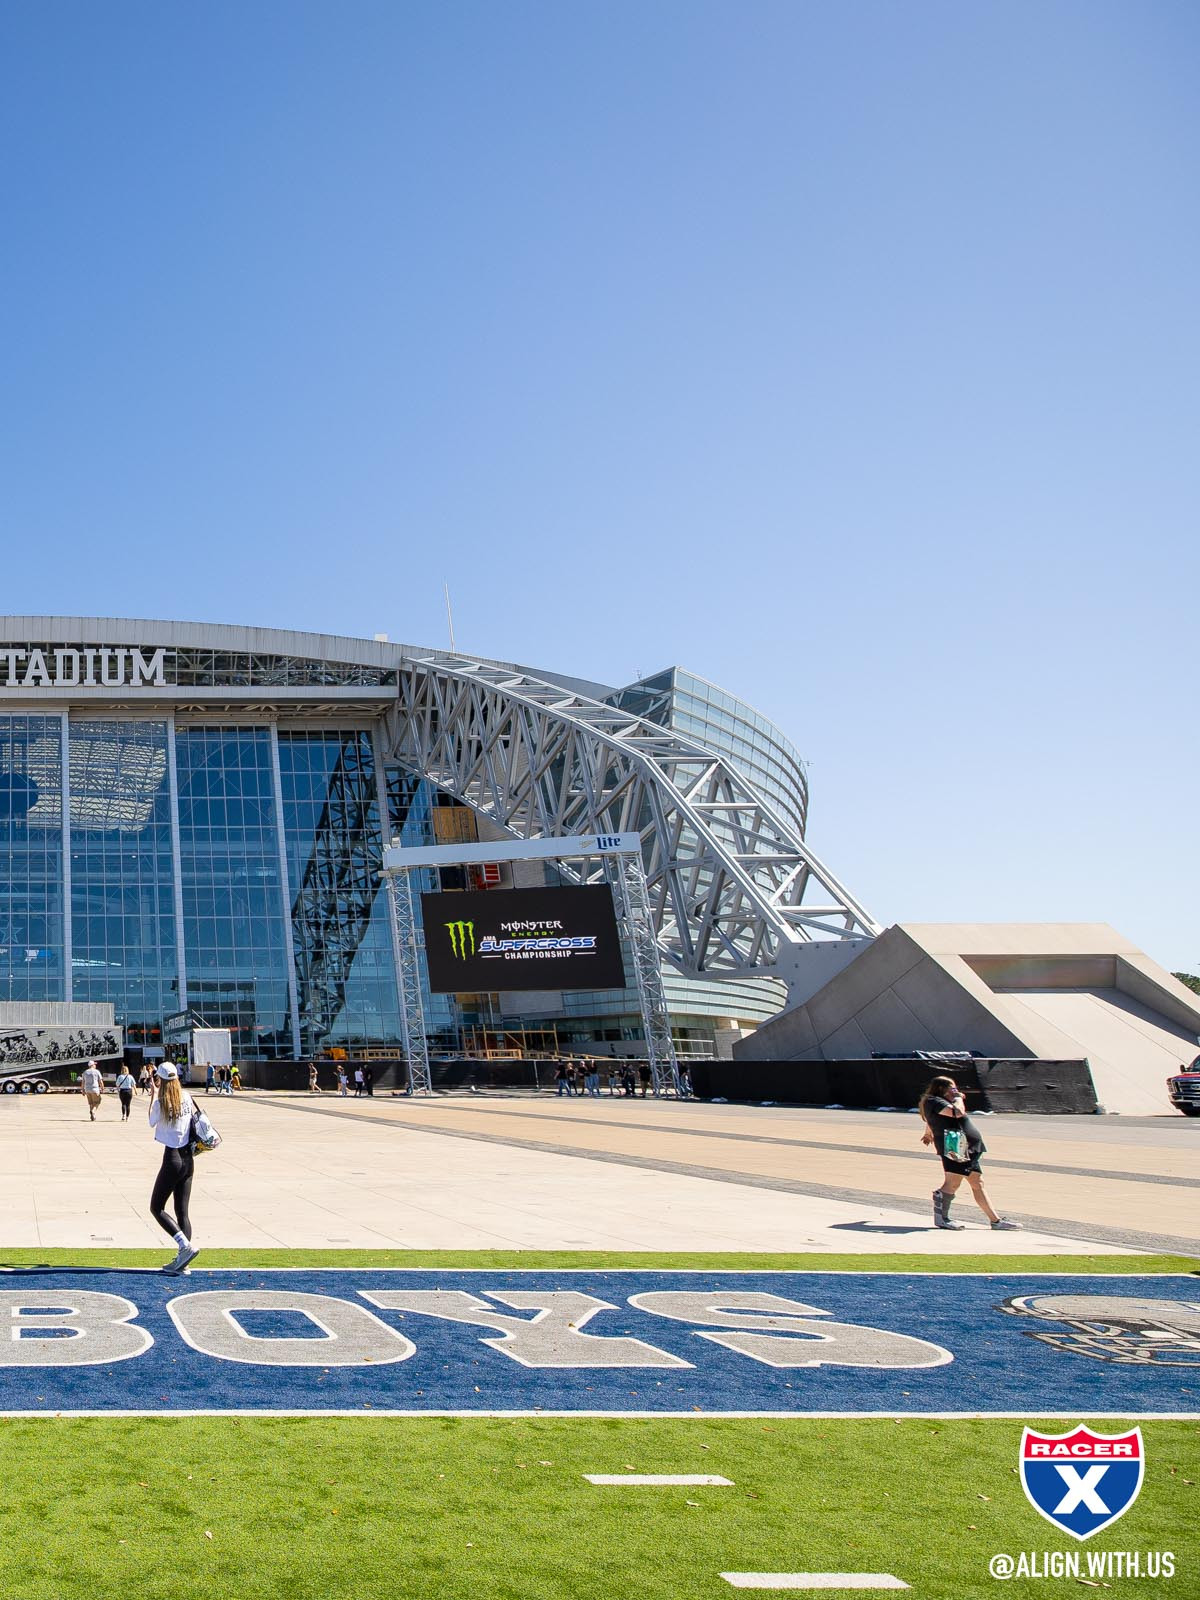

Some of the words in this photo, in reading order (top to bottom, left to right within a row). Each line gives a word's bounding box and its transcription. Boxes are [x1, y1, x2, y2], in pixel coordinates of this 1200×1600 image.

[596, 836, 621, 850] Lite
[501, 920, 563, 932] MONSTER
[479, 936, 597, 952] SUPERCROSS
[504, 950, 572, 960] CHAMPIONSHIP
